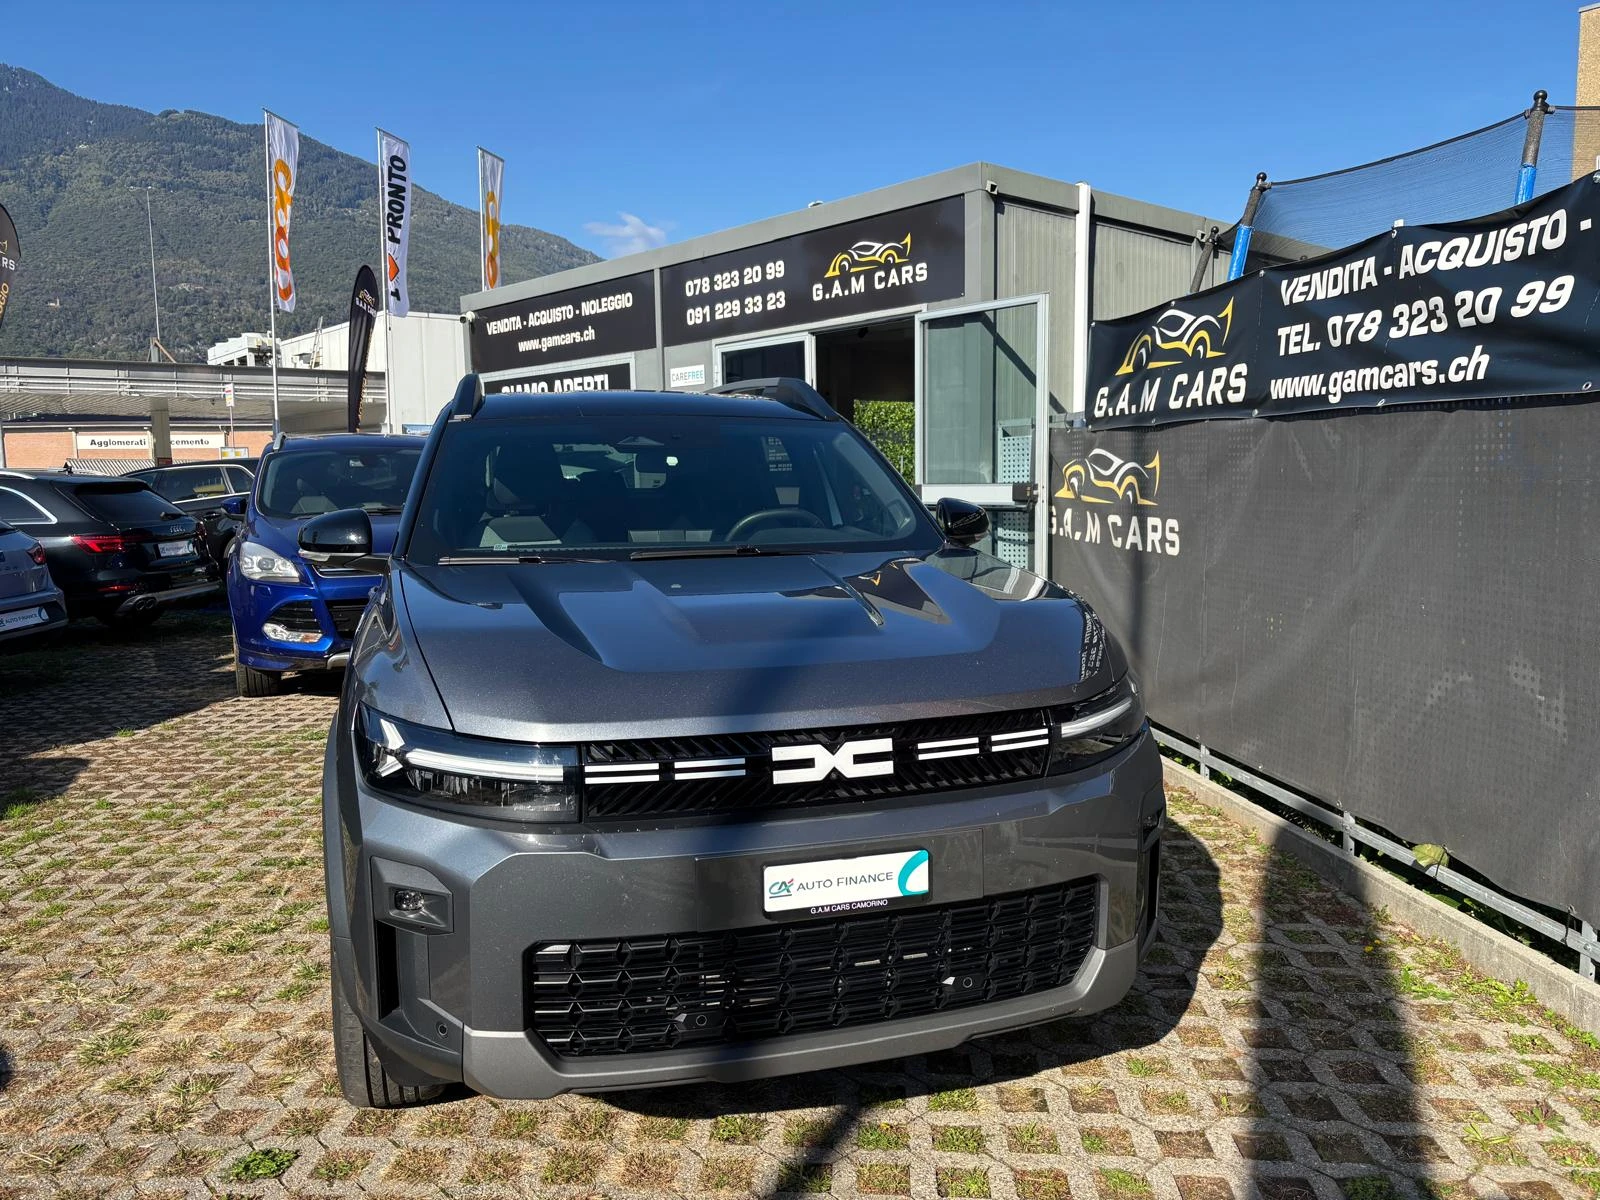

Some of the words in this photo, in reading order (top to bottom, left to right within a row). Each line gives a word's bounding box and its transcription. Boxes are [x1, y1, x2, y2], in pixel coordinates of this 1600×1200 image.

[386, 154, 407, 245] PRONTO
[1280, 256, 1378, 306] VENDITA
[1399, 208, 1567, 280] ACQUISTO
[685, 277, 710, 297] 078
[714, 270, 740, 291] 323
[743, 265, 762, 285] 20
[766, 260, 785, 280] 99
[812, 277, 866, 302] G.A.M
[874, 262, 928, 291] CARS
[486, 315, 523, 336] VENDITA
[528, 305, 574, 328] ACQUISTO
[581, 292, 633, 317] NOLEGGIO
[686, 305, 711, 326] 091
[715, 299, 741, 320] 229
[744, 295, 763, 315] 33
[767, 291, 786, 311] 23
[1277, 325, 1321, 357] TEL.
[1326, 309, 1383, 348] 078
[1388, 296, 1449, 340] 323
[1454, 286, 1504, 329] 20
[1510, 274, 1576, 319] 99
[518, 325, 596, 352] www.gamcars.ch
[671, 369, 704, 382] CAREFREE
[1093, 377, 1162, 418] G.A.M
[1168, 363, 1248, 410] CARS
[1269, 344, 1490, 404] www.gamcars.ch
[90, 438, 146, 448] Agglomerati
[1107, 514, 1180, 556] CARS
[796, 878, 833, 892] AUTO
[836, 871, 894, 887] FINANCE
[810, 905, 831, 915] G.A.M
[831, 903, 850, 913] CARS
[851, 899, 889, 910] CAMORINO
